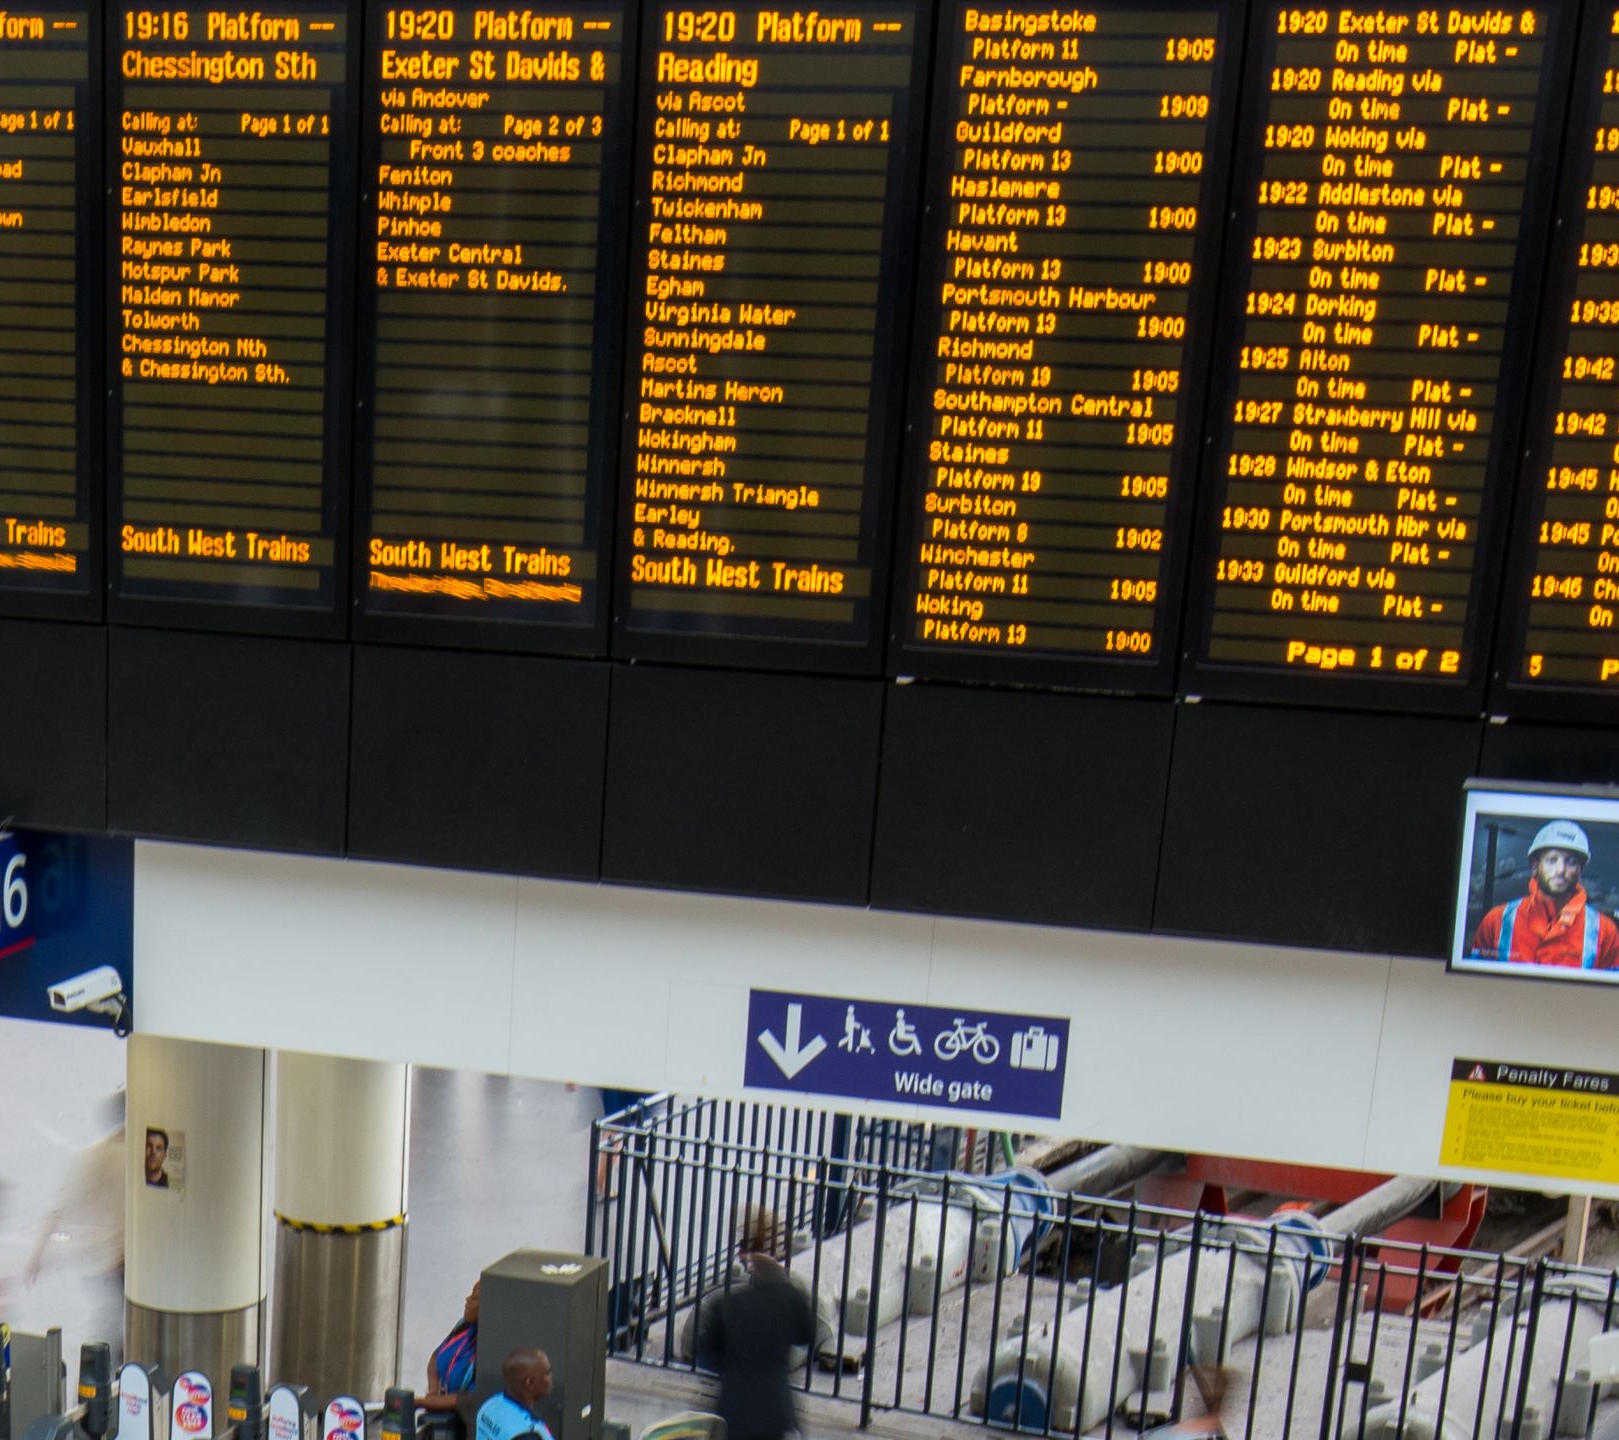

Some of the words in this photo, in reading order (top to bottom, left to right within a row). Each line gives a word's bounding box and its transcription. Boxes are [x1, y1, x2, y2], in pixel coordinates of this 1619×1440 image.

[1277, 10, 1329, 34] 19:20
[1338, 9, 1410, 34] Exeter
[1416, 10, 1440, 34] St
[1447, 10, 1513, 35] Davids
[1519, 10, 1536, 35] &
[123, 50, 266, 84] Chessington
[276, 51, 318, 80] Sth
[382, 50, 461, 80] Exeter
[470, 50, 498, 80] St
[506, 50, 582, 81] Davids
[591, 50, 606, 81] &
[942, 283, 1061, 308] Portsmouth
[1068, 287, 1156, 310] Harbour
[1234, 400, 1284, 424] 19:27
[1292, 402, 1405, 433] Strawberry
[1409, 407, 1442, 430] Hill
[1446, 409, 1477, 432] via
[1286, 640, 1356, 670] Page
[1370, 646, 1383, 668] 1
[1395, 648, 1428, 671] of
[1439, 650, 1460, 673] 2
[894, 1071, 944, 1097] Wide
[948, 1079, 992, 1102] gate
[1497, 1065, 1558, 1088] Penalty
[1563, 1071, 1610, 1091] Fares
[1463, 1088, 1502, 1102] Please
[1506, 1092, 1527, 1107] buy
[1530, 1097, 1557, 1109] your
[1561, 1098, 1591, 1112] ticket
